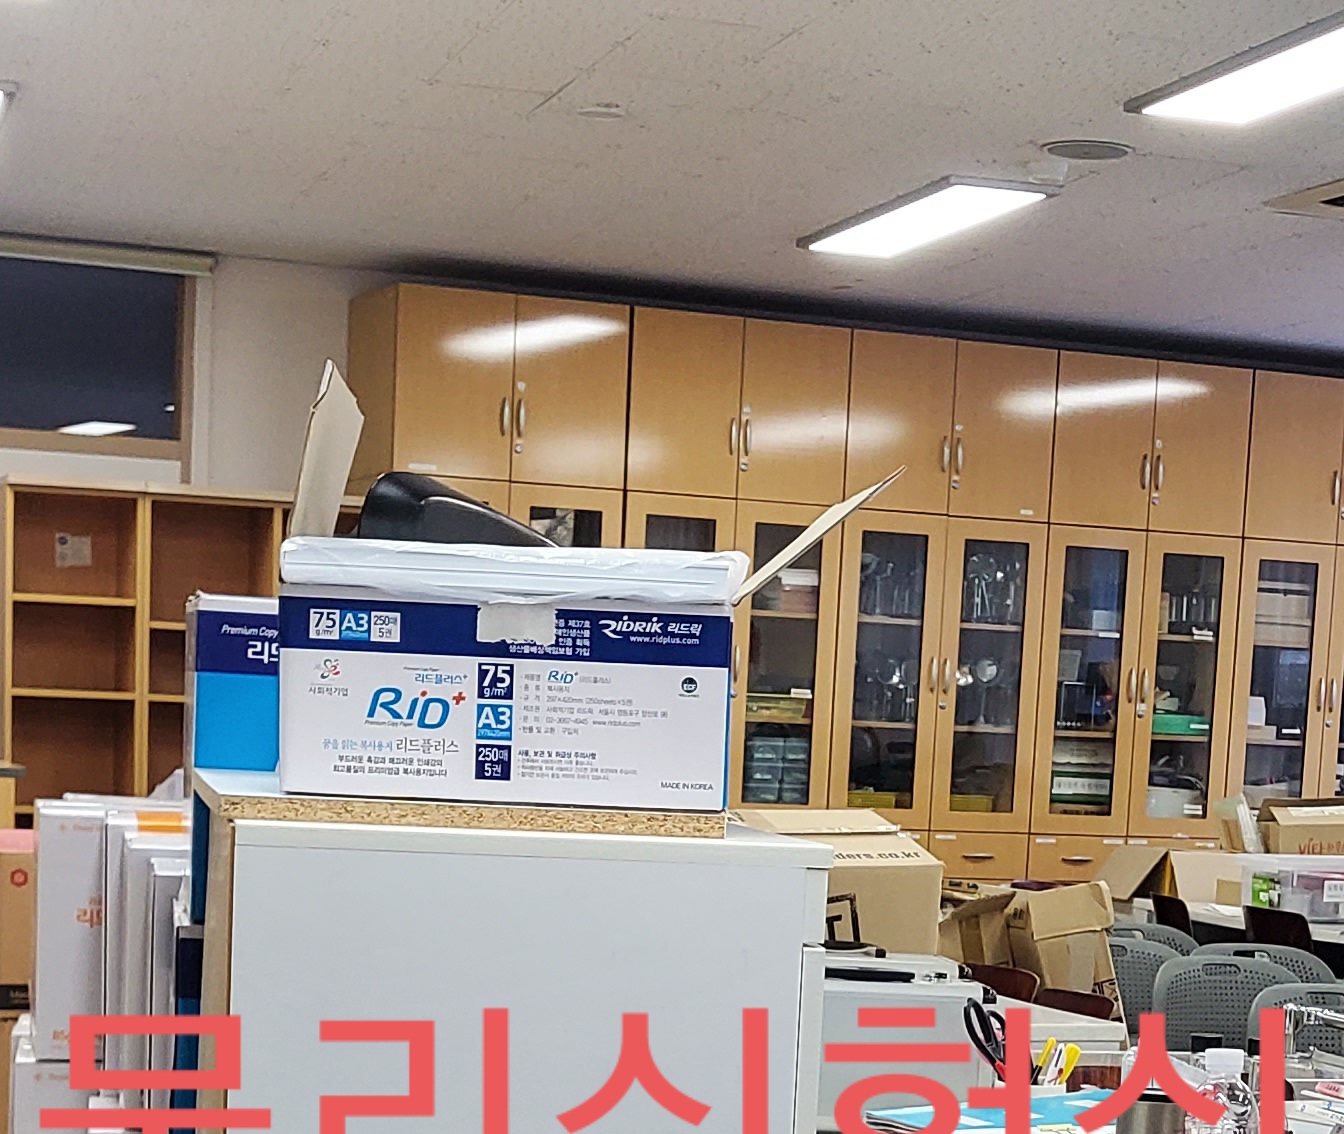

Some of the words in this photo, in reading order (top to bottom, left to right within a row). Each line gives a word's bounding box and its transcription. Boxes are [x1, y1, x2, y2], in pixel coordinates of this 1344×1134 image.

[312, 611, 337, 629] 75
[341, 612, 369, 631] A3
[221, 624, 258, 636] Premium
[259, 626, 279, 639] Copy
[667, 622, 702, 636] 리드릭
[629, 635, 700, 645] www.ridplus.com
[481, 664, 511, 688] 75
[477, 706, 511, 730] A3
[396, 737, 459, 755] 리드플러스
[484, 763, 502, 777] 5권
[661, 781, 680, 789] MADE
[691, 782, 713, 790] KOREA
